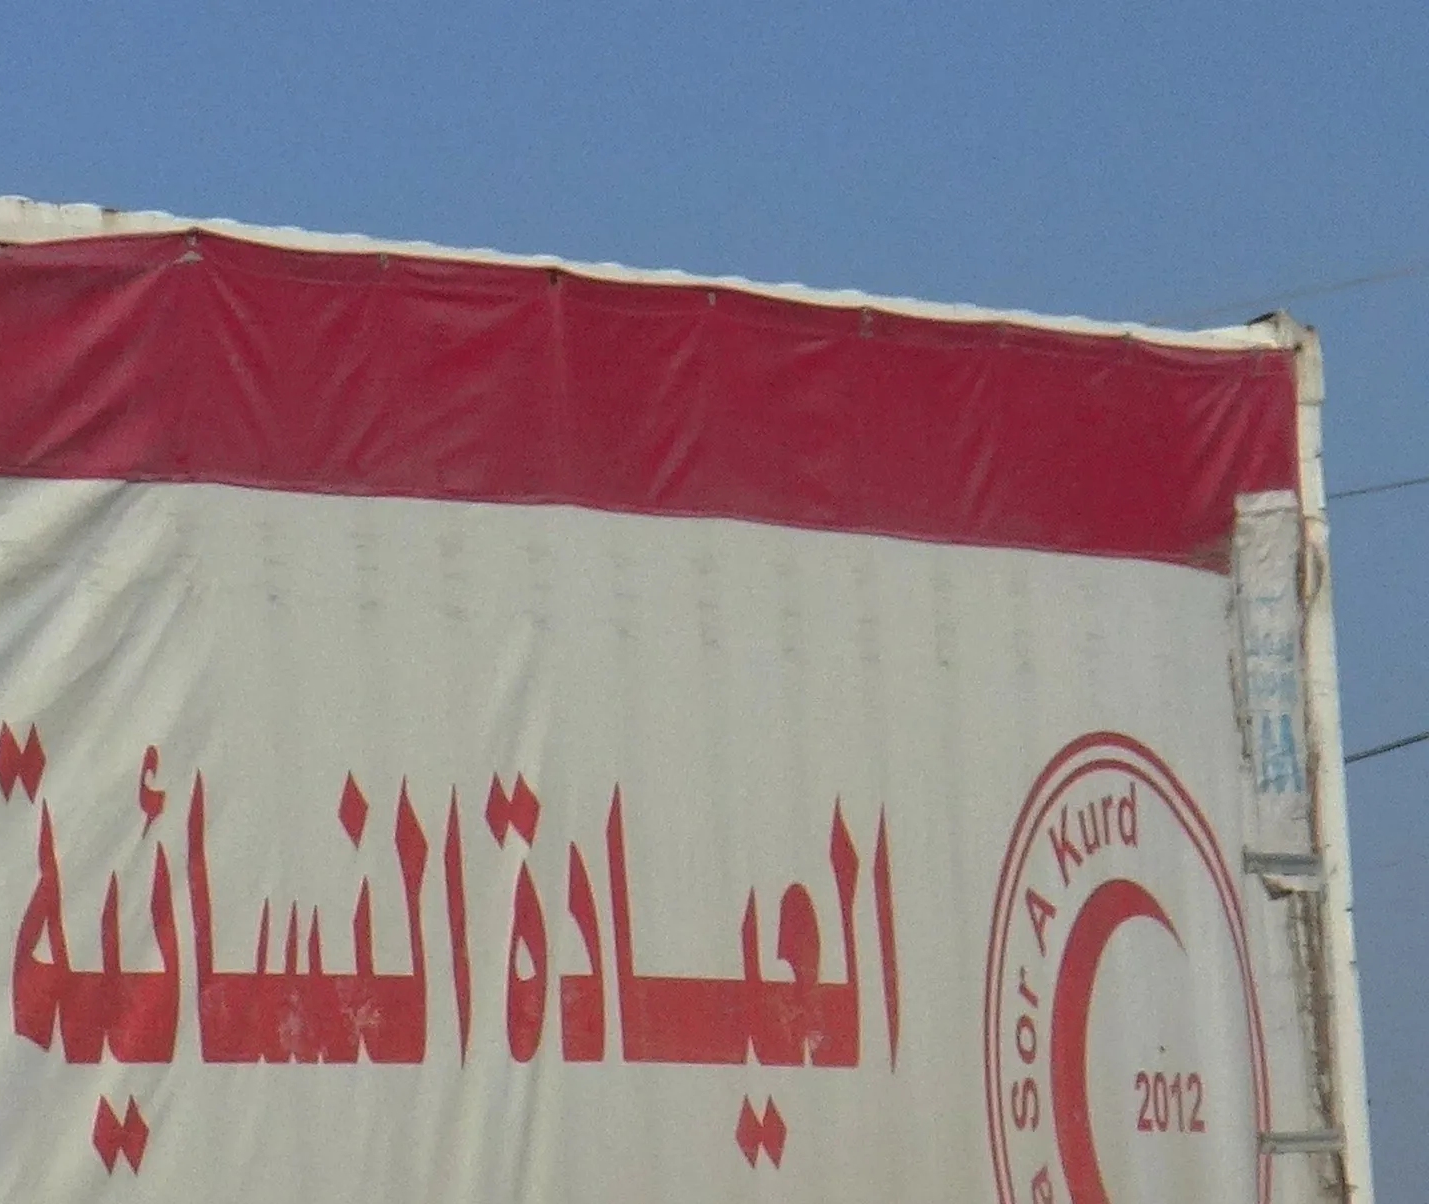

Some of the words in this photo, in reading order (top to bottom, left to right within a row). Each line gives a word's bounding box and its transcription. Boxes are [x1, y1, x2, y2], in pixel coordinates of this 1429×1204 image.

[1049, 782, 1140, 888] Kurd
[484, 770, 901, 1172] العيادة
[1024, 886, 1058, 957] A
[1012, 965, 1040, 1132] Sor
[1134, 1070, 1208, 1134] 2012
